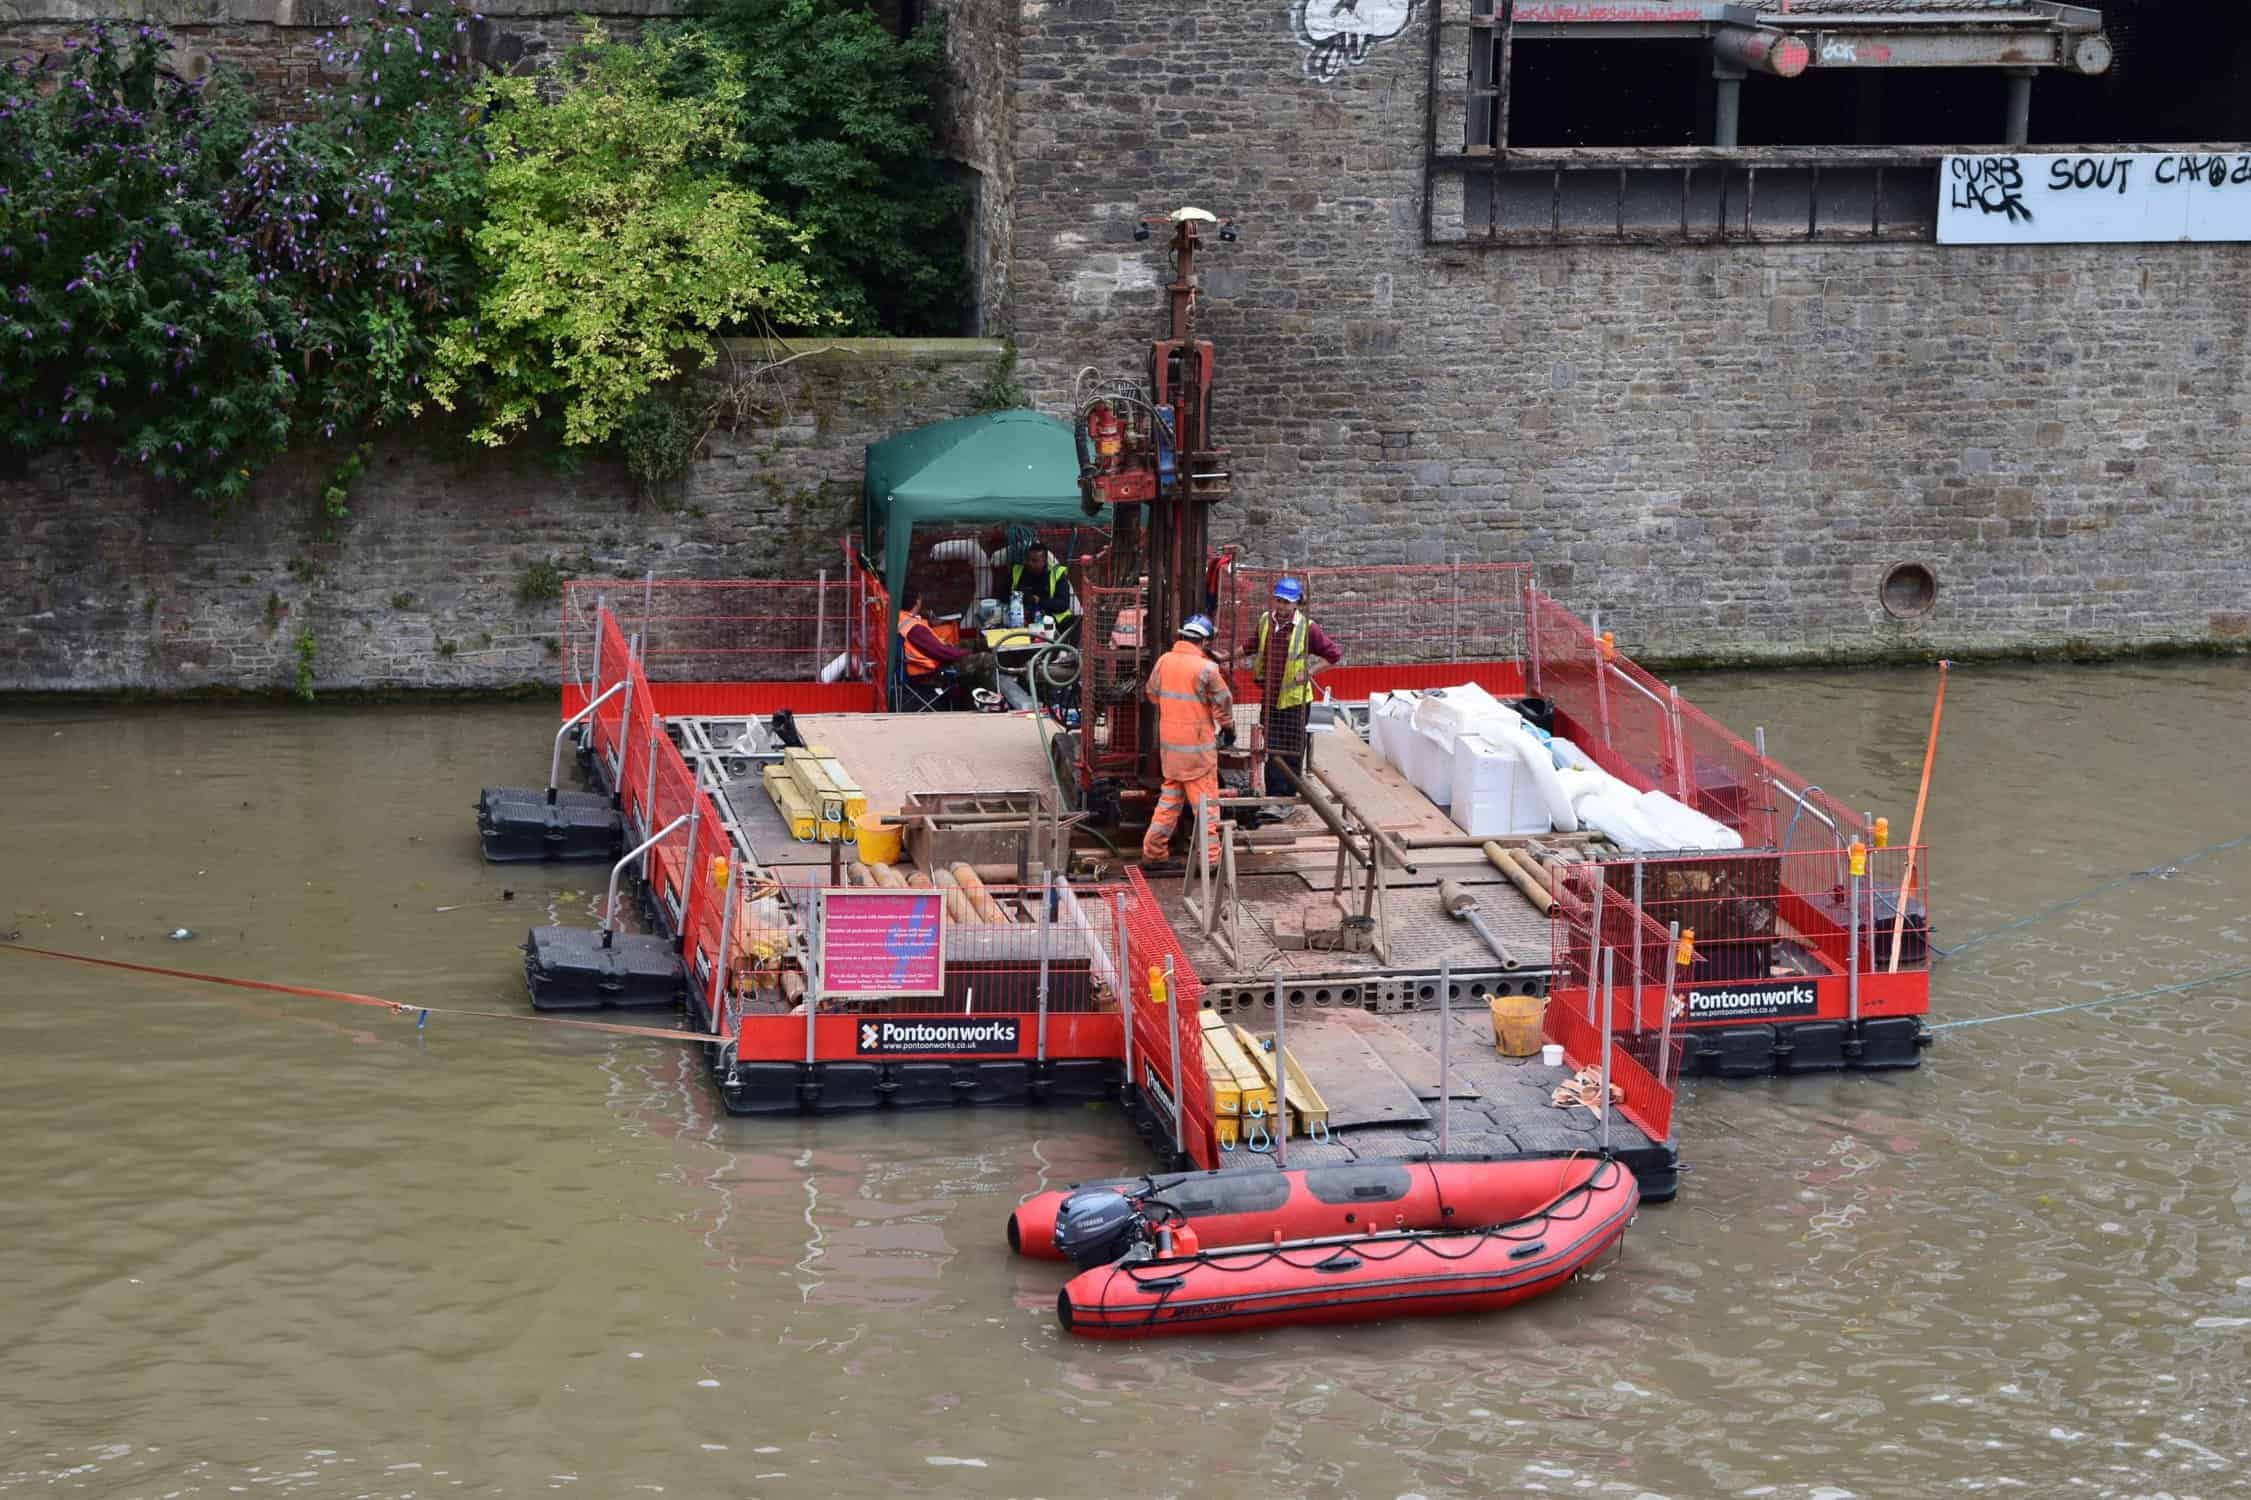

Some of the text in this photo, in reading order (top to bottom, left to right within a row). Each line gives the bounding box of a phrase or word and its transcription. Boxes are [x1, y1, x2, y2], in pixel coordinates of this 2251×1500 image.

[2048, 157, 2134, 194] SOUT
[1689, 985, 1814, 1010] Pontoonworks
[1690, 1006, 1778, 1018] www.pontoonworks.co.uk
[883, 1021, 1015, 1041] Pontoonworks
[883, 1041, 976, 1050] www.pontoonworks.co.uk
